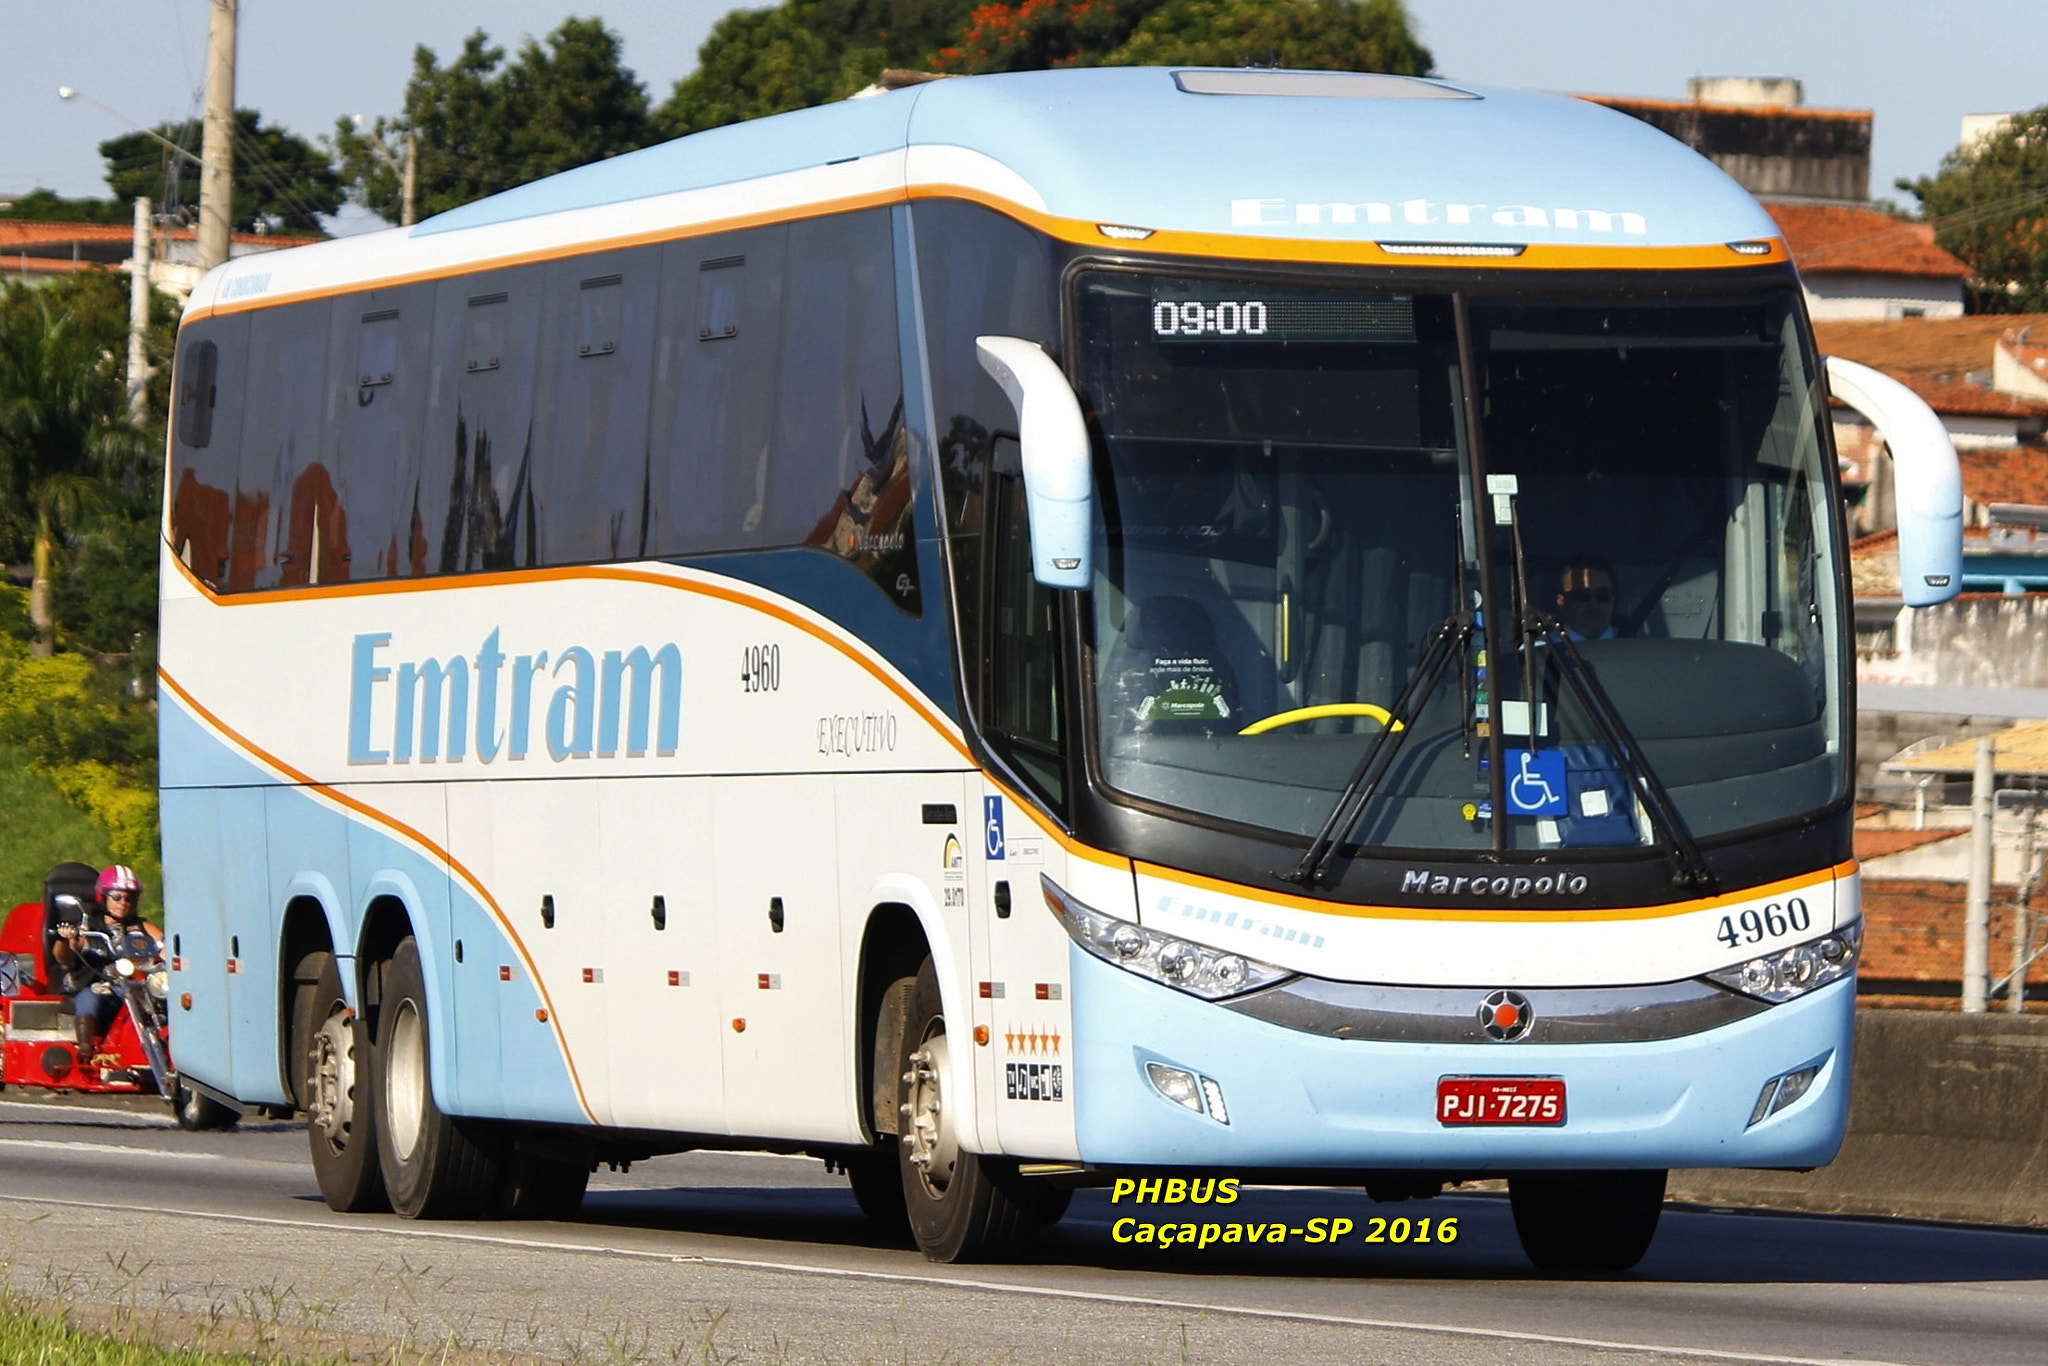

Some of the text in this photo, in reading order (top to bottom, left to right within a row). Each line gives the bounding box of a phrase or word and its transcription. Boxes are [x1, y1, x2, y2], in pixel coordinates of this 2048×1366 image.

[1230, 198, 1647, 234] Emtram
[1153, 301, 1268, 336] 09:00
[741, 643, 780, 693] 4960
[347, 624, 682, 767] Emtram
[1170, 702, 1205, 710] Marcopolo
[817, 709, 897, 757] EXECUTIVO
[1401, 869, 1588, 899] Marcopolo
[1156, 895, 1326, 949] Emtram
[1716, 897, 1811, 949] 4960
